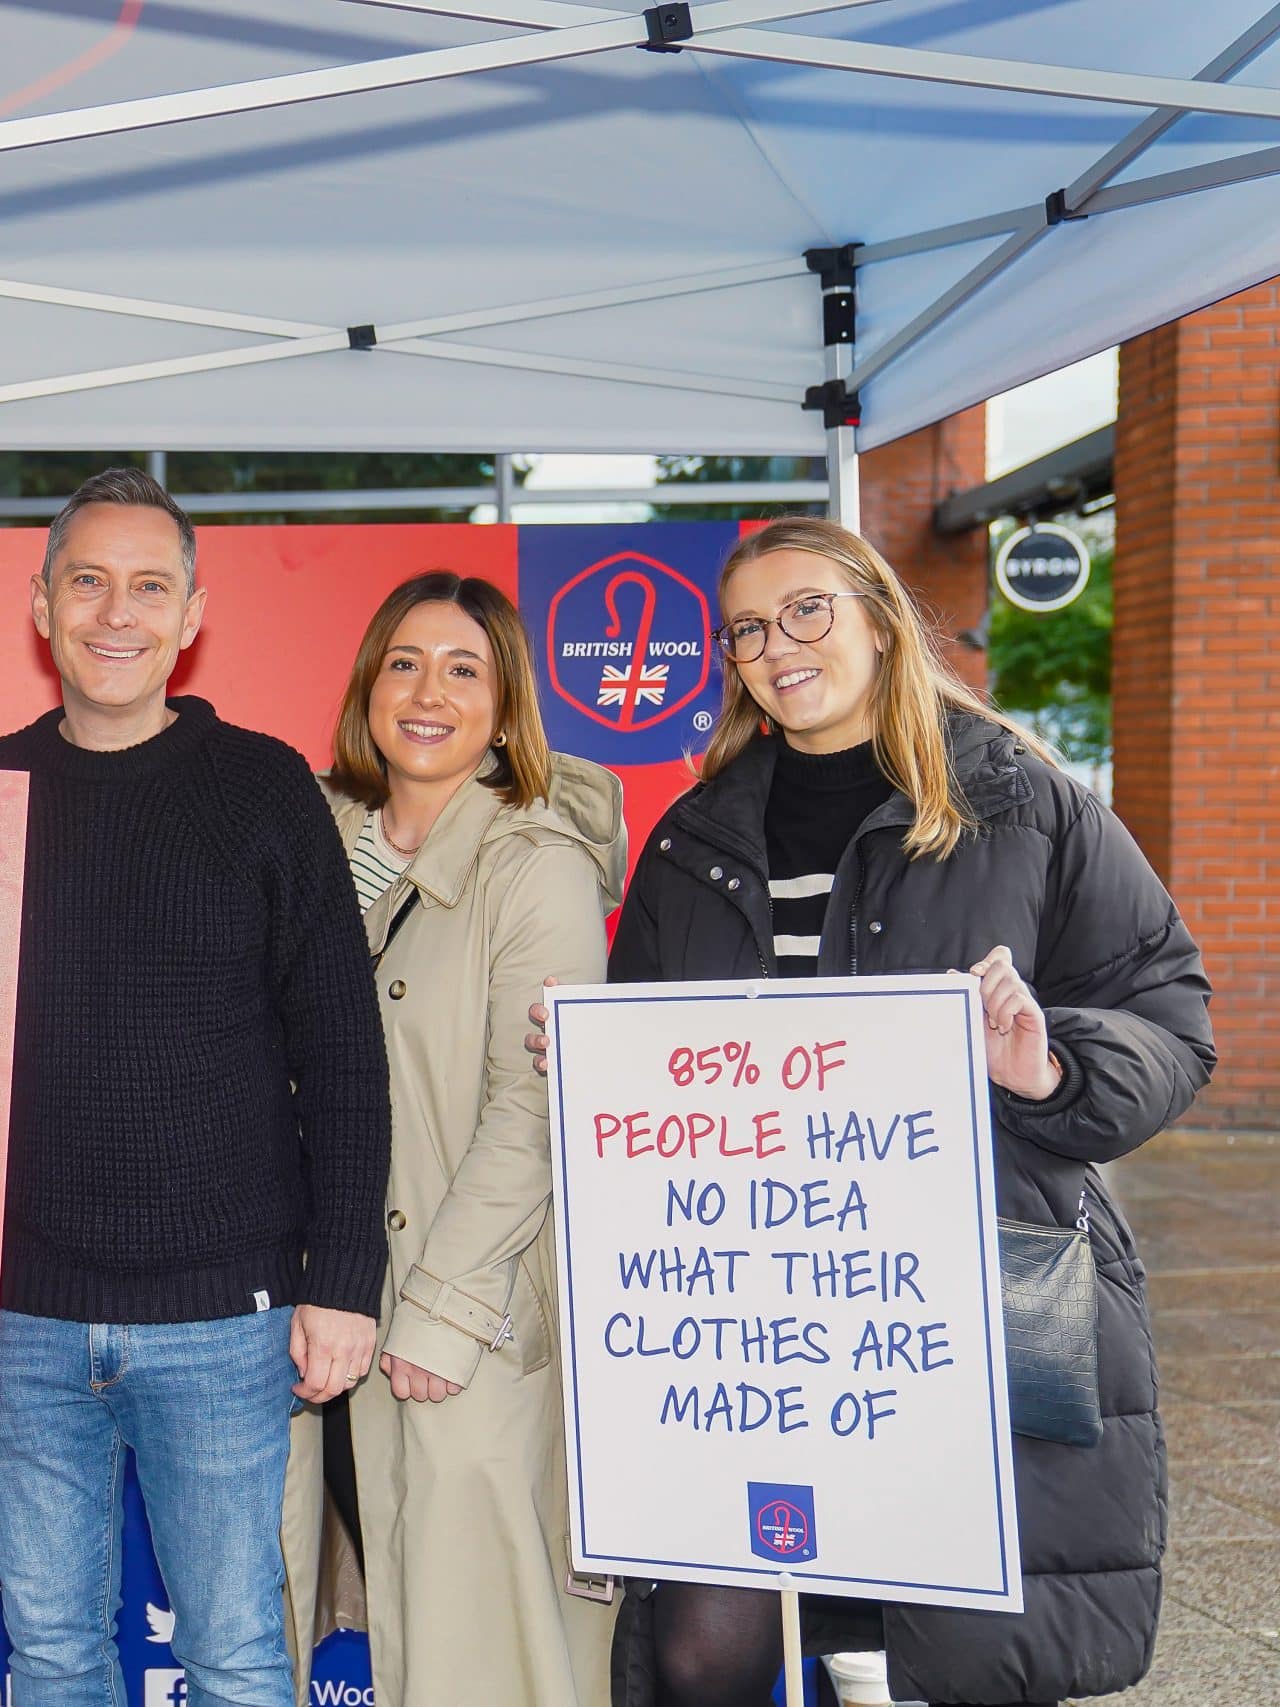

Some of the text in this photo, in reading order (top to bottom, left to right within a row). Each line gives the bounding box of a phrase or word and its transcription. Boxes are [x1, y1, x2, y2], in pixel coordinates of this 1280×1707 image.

[562, 641, 702, 657] BRITISH WOOL
[667, 1040, 847, 1092] 85% OF
[593, 1110, 940, 1163] PEOPLE HAVE
[666, 1177, 868, 1233] NO IDEA
[618, 1246, 926, 1304] WHAT THEIR
[604, 1311, 954, 1374] CLOTHES ARE
[659, 1381, 898, 1441] MADE OF
